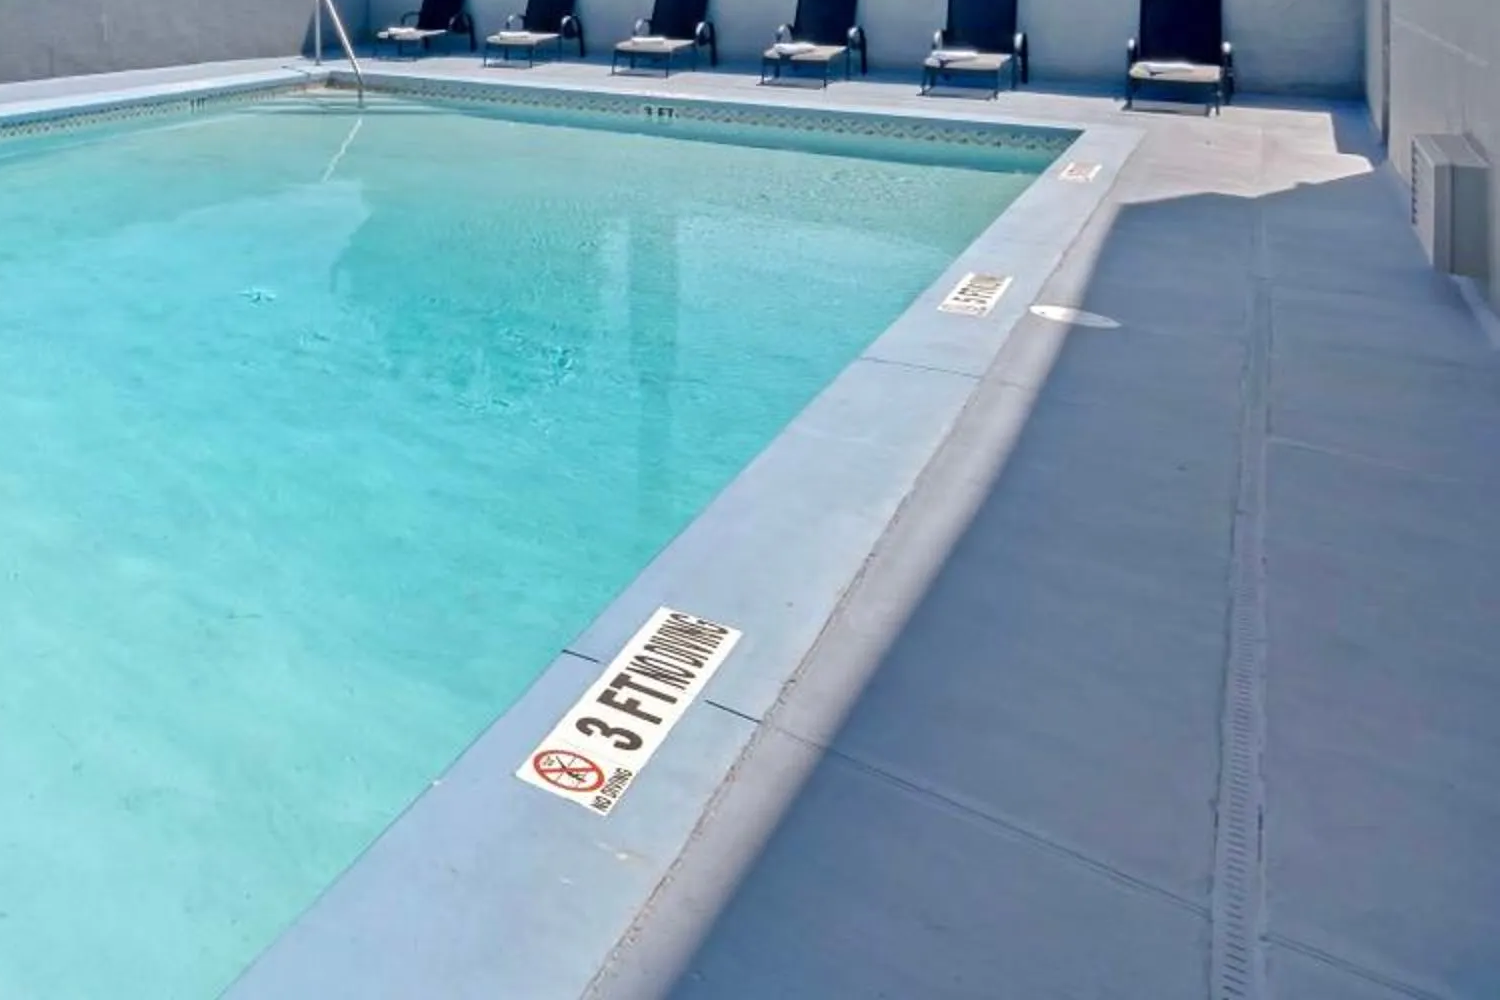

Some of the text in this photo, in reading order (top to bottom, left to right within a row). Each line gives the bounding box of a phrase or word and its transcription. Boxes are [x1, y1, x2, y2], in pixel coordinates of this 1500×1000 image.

[575, 612, 730, 751] 3 FT NO DIVING
